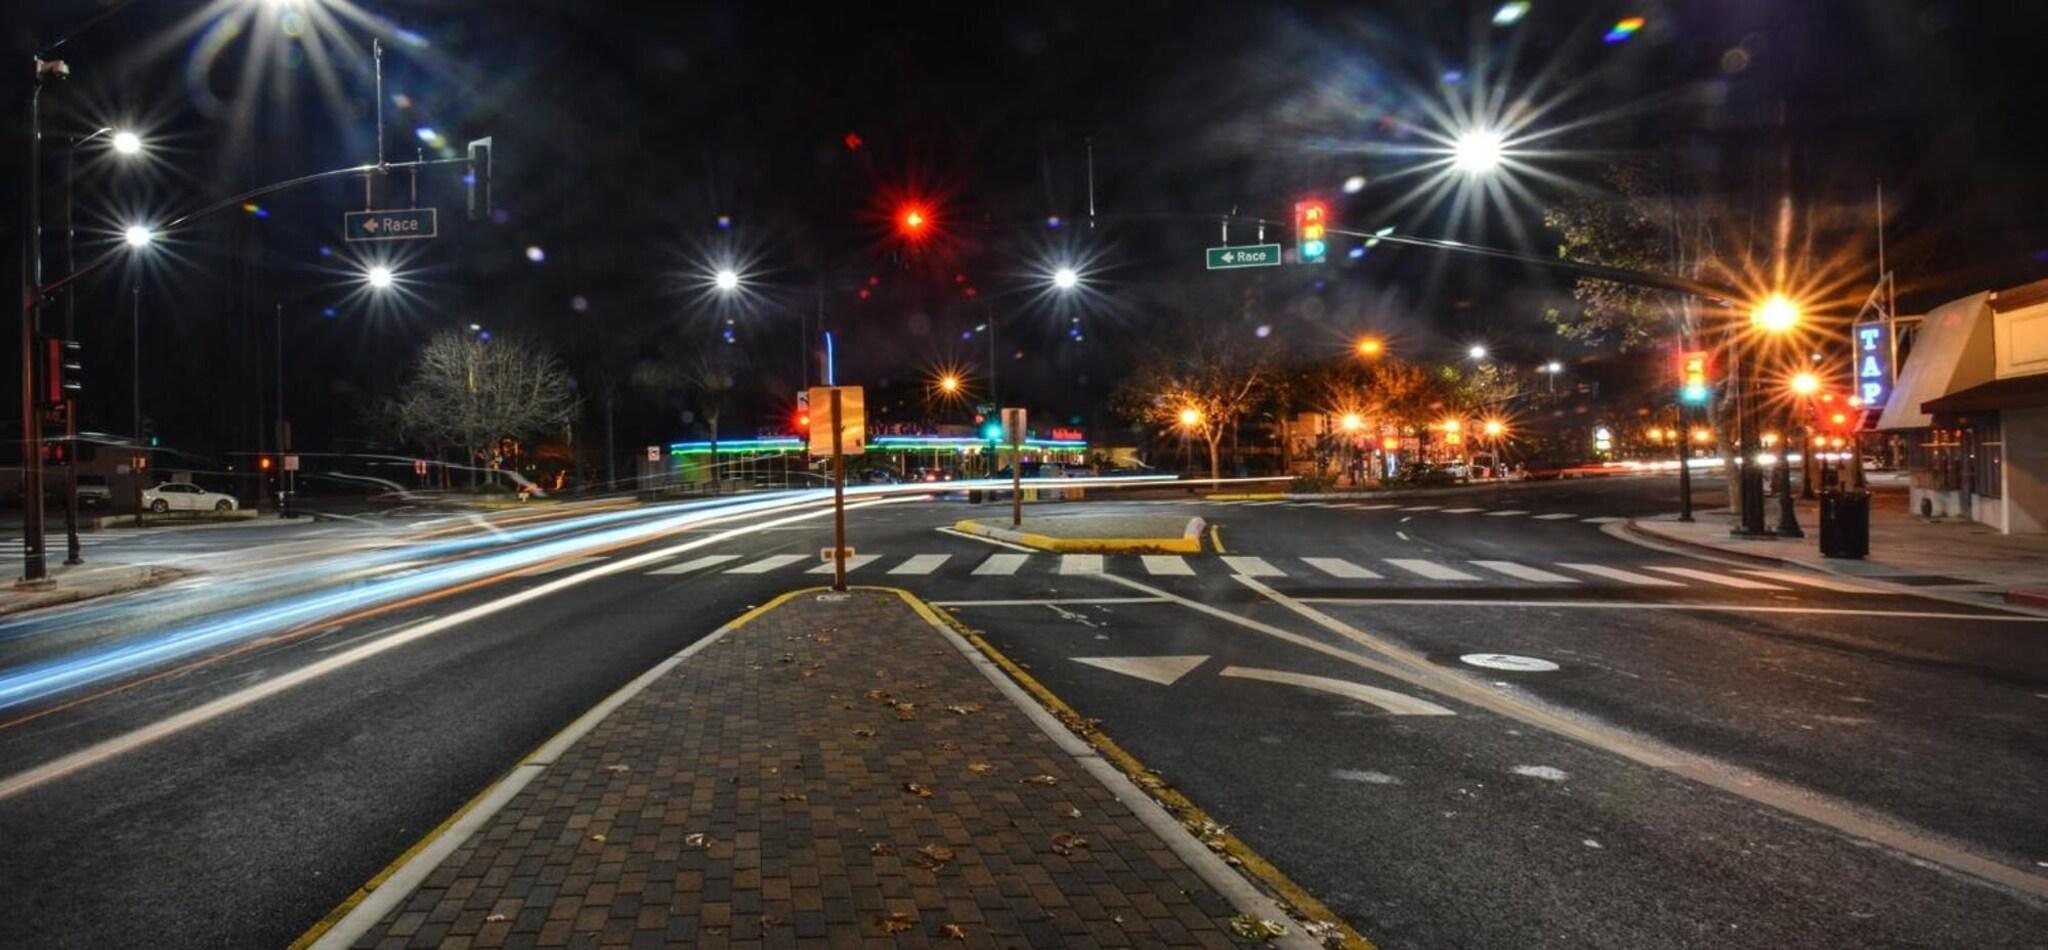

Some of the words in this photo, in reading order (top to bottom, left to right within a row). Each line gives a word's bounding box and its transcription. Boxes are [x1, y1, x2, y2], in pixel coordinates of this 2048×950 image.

[383, 217, 418, 232] Race
[1237, 251, 1266, 262] Race
[1860, 328, 1883, 404] TAP
